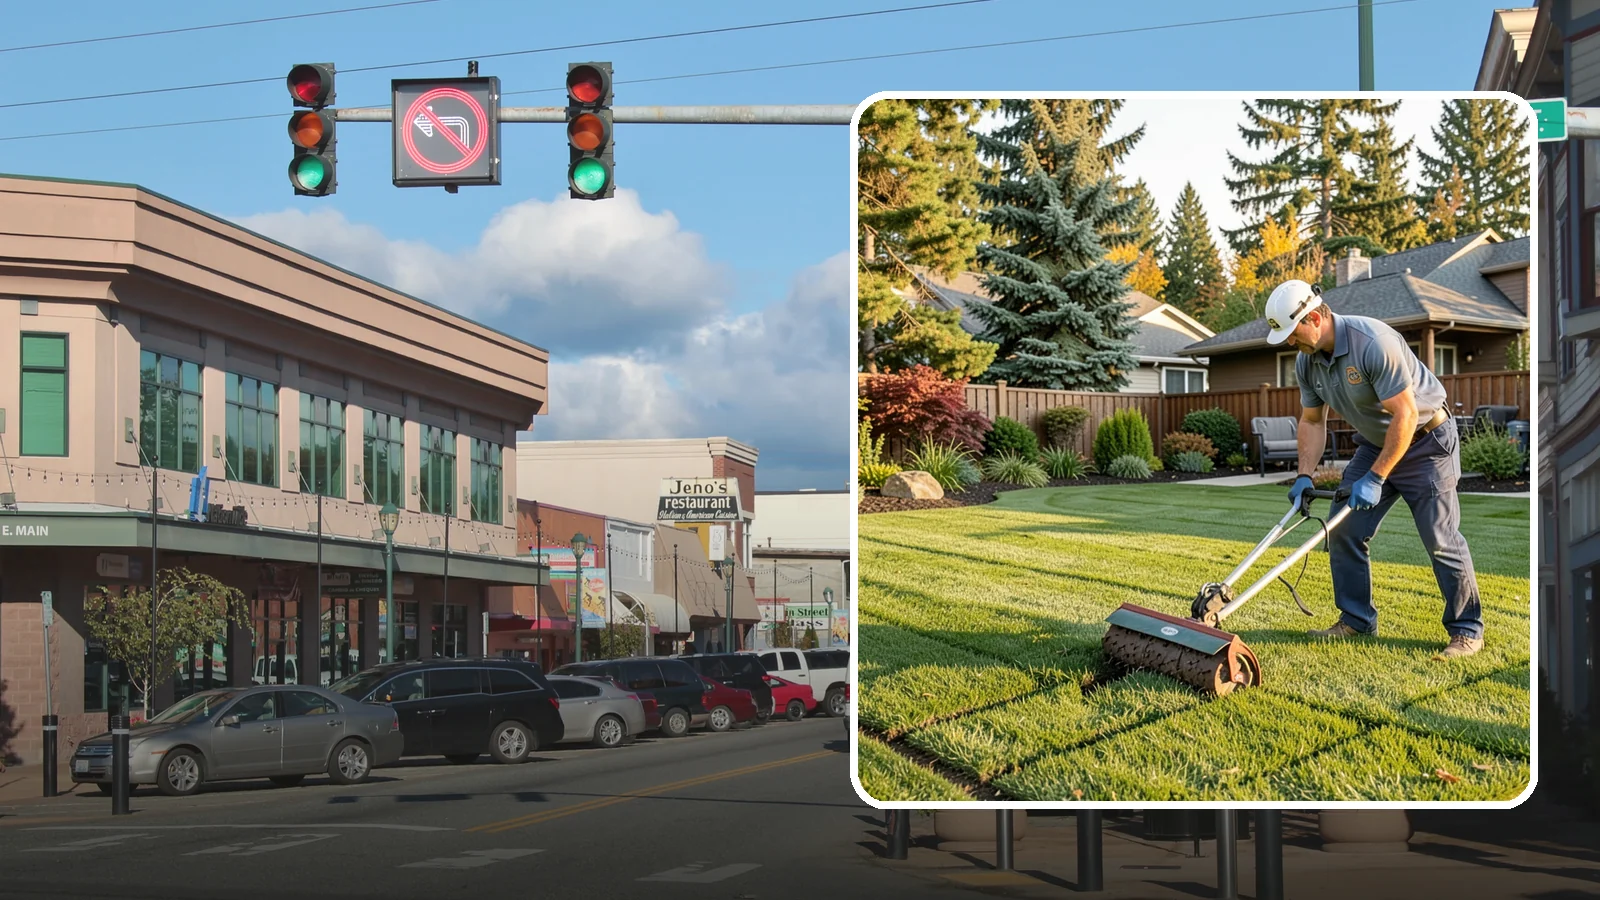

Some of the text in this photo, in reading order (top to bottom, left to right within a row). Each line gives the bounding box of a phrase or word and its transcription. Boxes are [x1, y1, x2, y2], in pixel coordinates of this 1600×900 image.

[670, 480, 727, 494] Jeno's
[665, 496, 731, 509] restaurant
[659, 510, 681, 520] Italian
[686, 510, 714, 519] American
[715, 509, 737, 519] Cuisine
[2, 525, 49, 536] E. MAIN
[797, 607, 828, 617] Street
